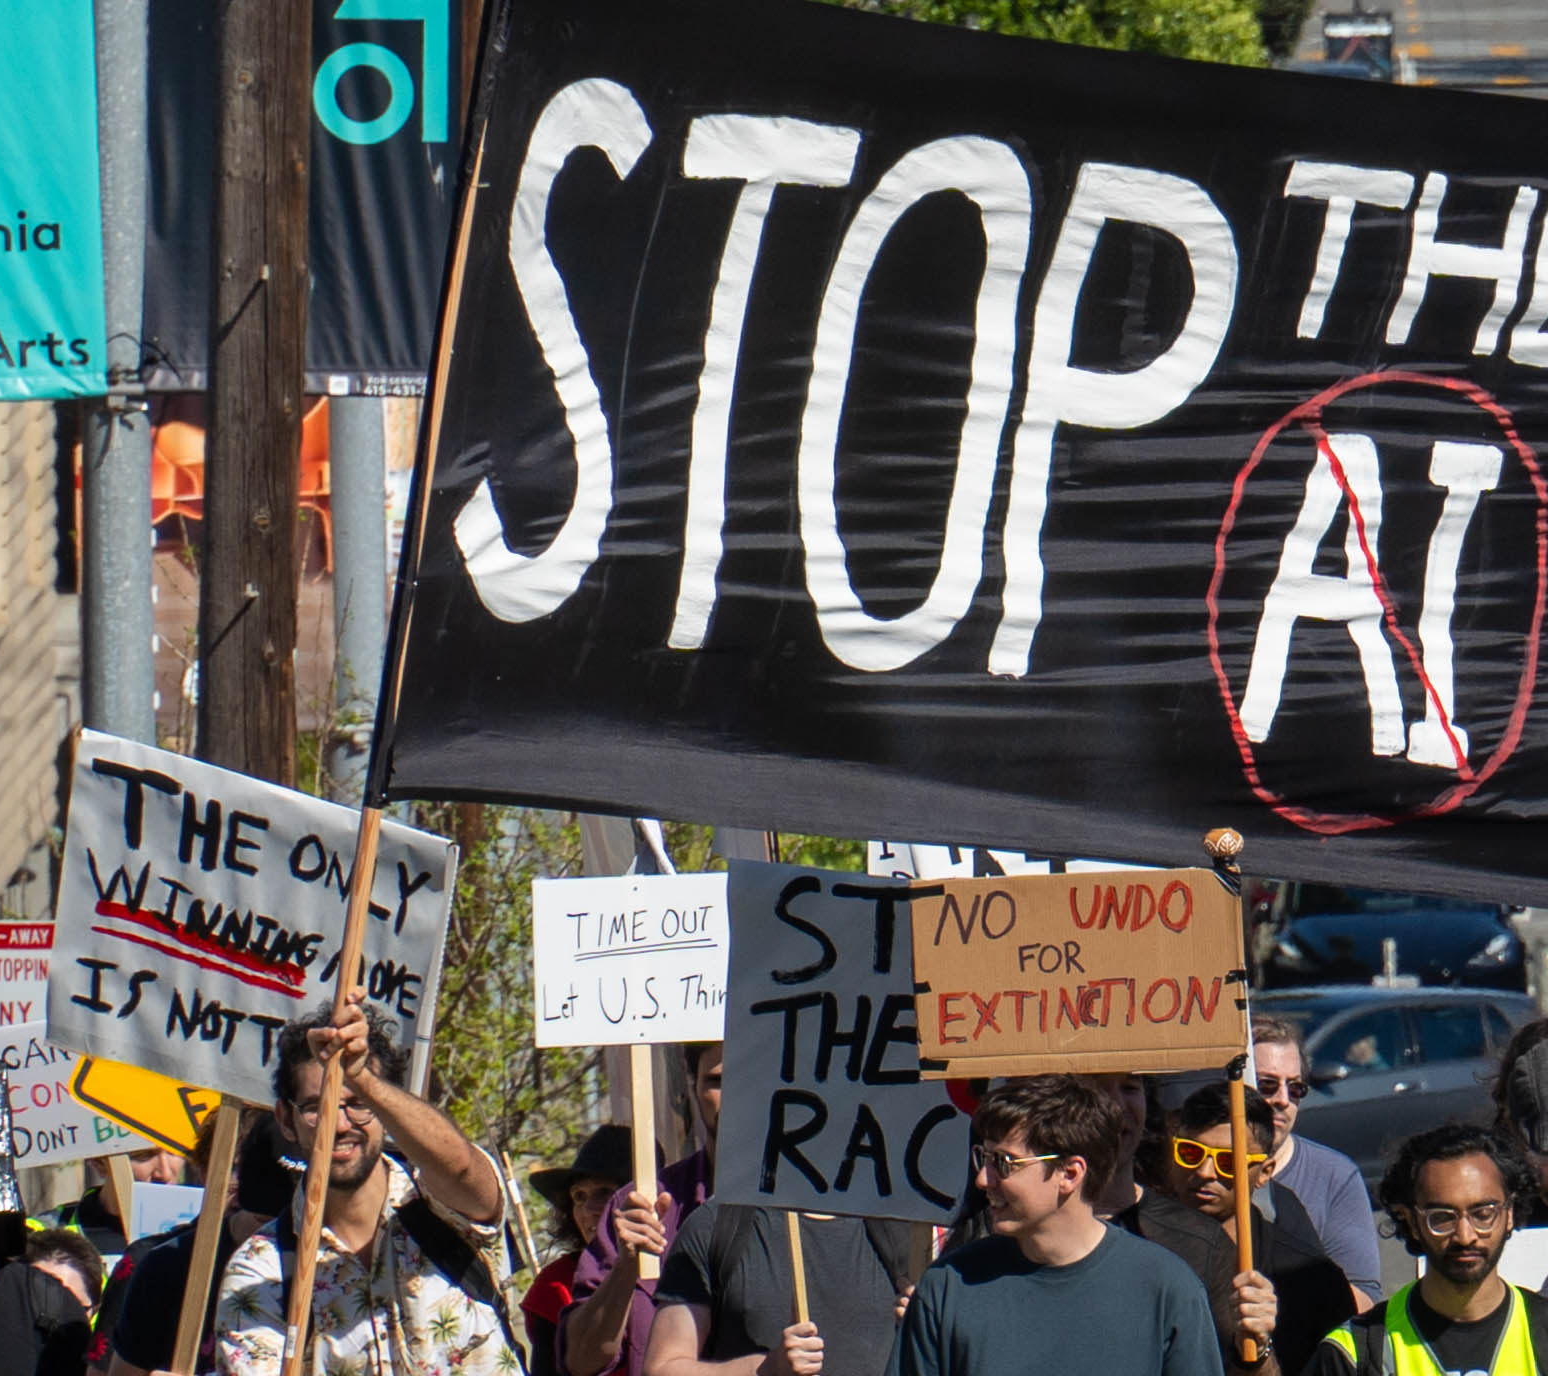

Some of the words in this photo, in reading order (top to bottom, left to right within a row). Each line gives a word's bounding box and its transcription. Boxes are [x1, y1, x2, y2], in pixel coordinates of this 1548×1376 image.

[363, 385, 425, 396] 415-431-
[453, 76, 1240, 680] STOP
[1240, 432, 1504, 770] AI
[91, 758, 269, 875] THE
[86, 847, 324, 967] WINNING
[566, 909, 648, 949] TIME
[661, 905, 714, 939] OUT
[771, 874, 914, 986] ST
[933, 889, 1018, 947] NO
[1070, 879, 1194, 933] UNDO
[542, 982, 579, 1022] Let
[598, 976, 667, 1024] U.S.
[680, 973, 728, 1011] Thin
[1018, 942, 1086, 975] FOR
[70, 957, 158, 1020] IS
[165, 985, 245, 1055] NOT
[750, 991, 921, 1086] THE
[937, 976, 1225, 1046] EXTINCTION
[12, 1123, 79, 1159] DON'T
[758, 1087, 956, 1212] RAC
